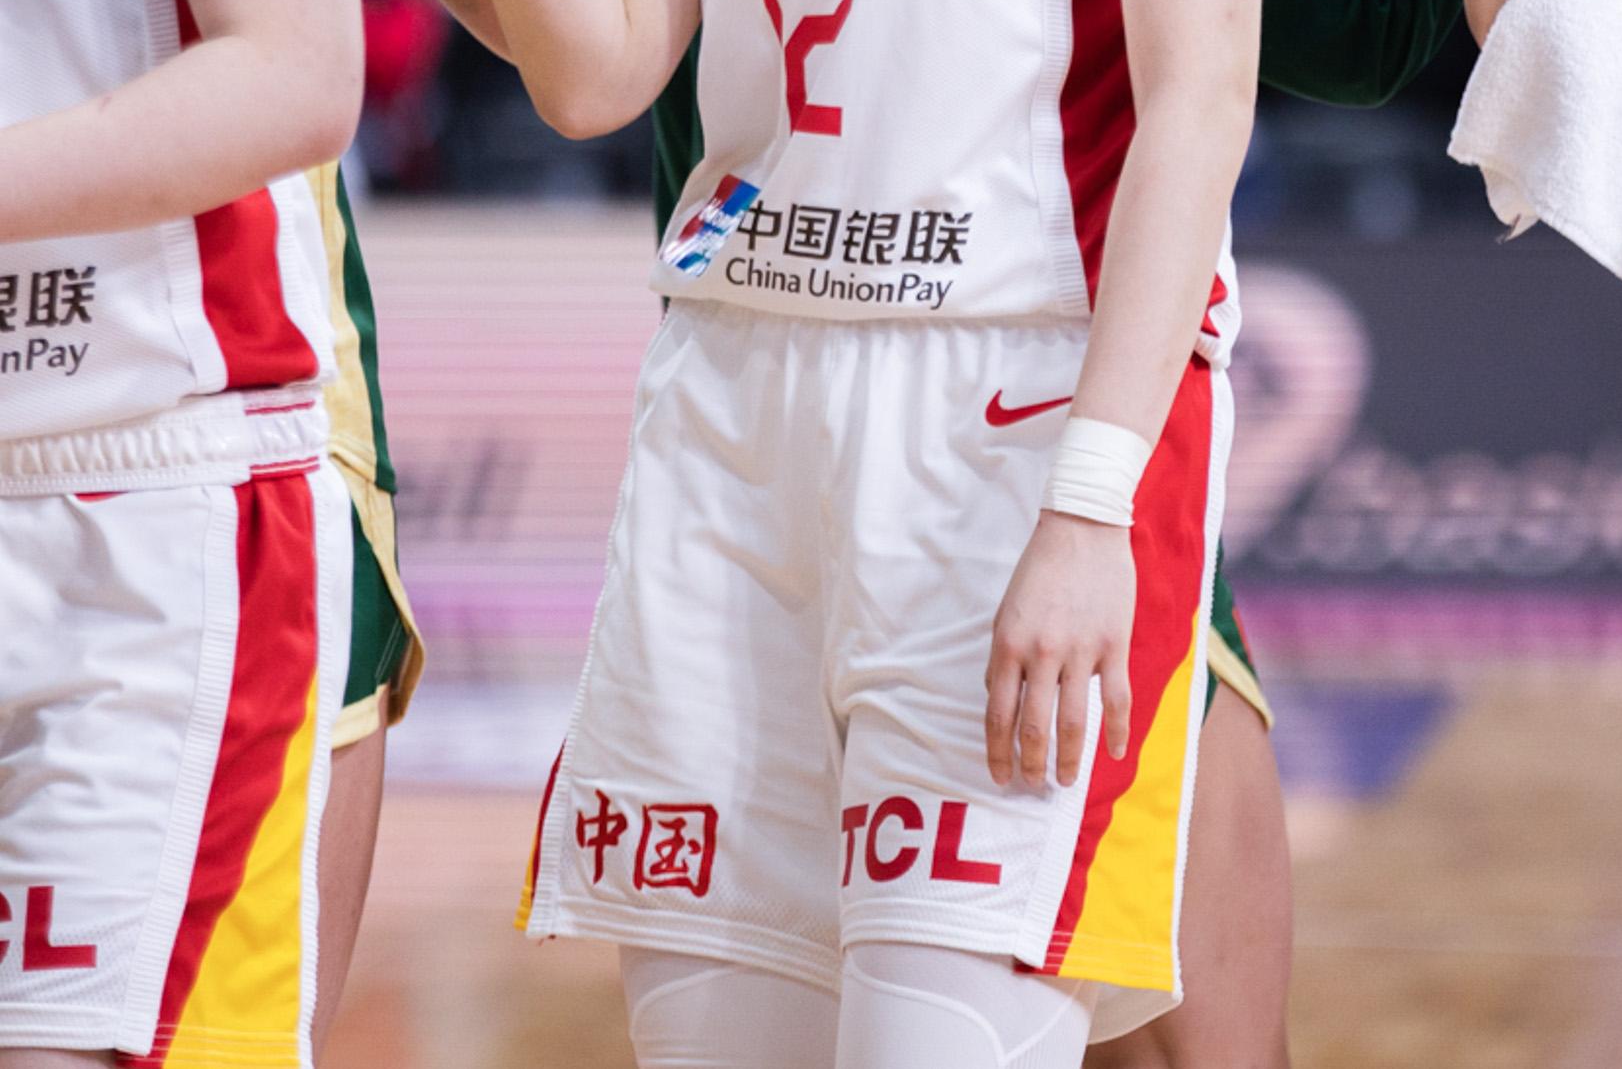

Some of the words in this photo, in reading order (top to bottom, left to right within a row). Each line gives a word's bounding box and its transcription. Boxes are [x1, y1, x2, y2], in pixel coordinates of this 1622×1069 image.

[737, 199, 974, 266] 中国银联
[0, 266, 96, 332] 联
[726, 257, 800, 293] China
[807, 268, 954, 310] UnionPay
[0, 338, 90, 376] nPay
[575, 788, 719, 898] 中国
[841, 795, 1002, 888] TCL
